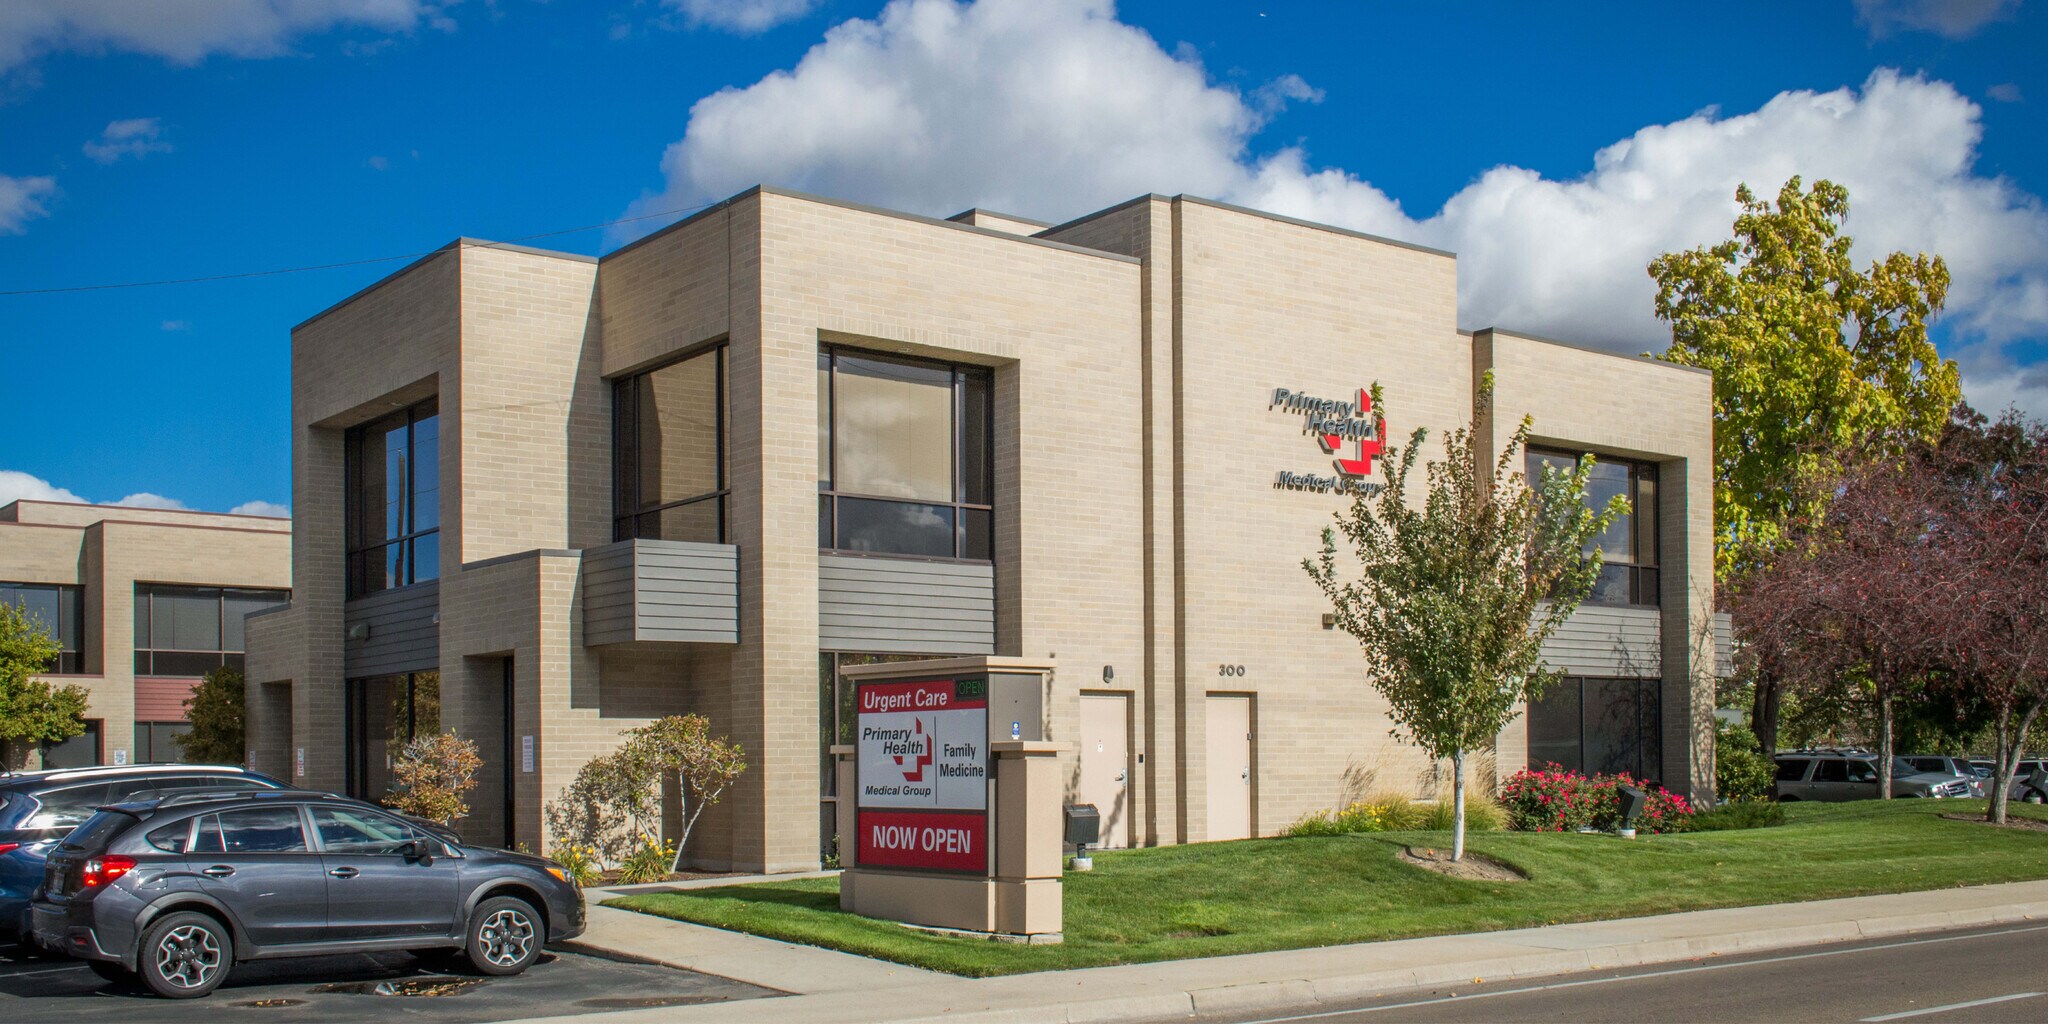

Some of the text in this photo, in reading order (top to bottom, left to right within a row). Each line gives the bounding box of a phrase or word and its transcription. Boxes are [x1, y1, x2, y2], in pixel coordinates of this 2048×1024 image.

[1273, 387, 1354, 418] Primary
[1307, 412, 1373, 438] Health
[1278, 471, 1336, 489] Medical
[1219, 664, 1245, 677] 300
[958, 681, 985, 694] OPEN
[864, 688, 947, 712] Urgent Care
[863, 727, 912, 742] Primary
[883, 741, 923, 755] Health
[944, 743, 976, 760] Family
[940, 763, 984, 777] Medicine
[865, 785, 931, 797] Medical Group
[873, 825, 971, 853] NOW OPEN
